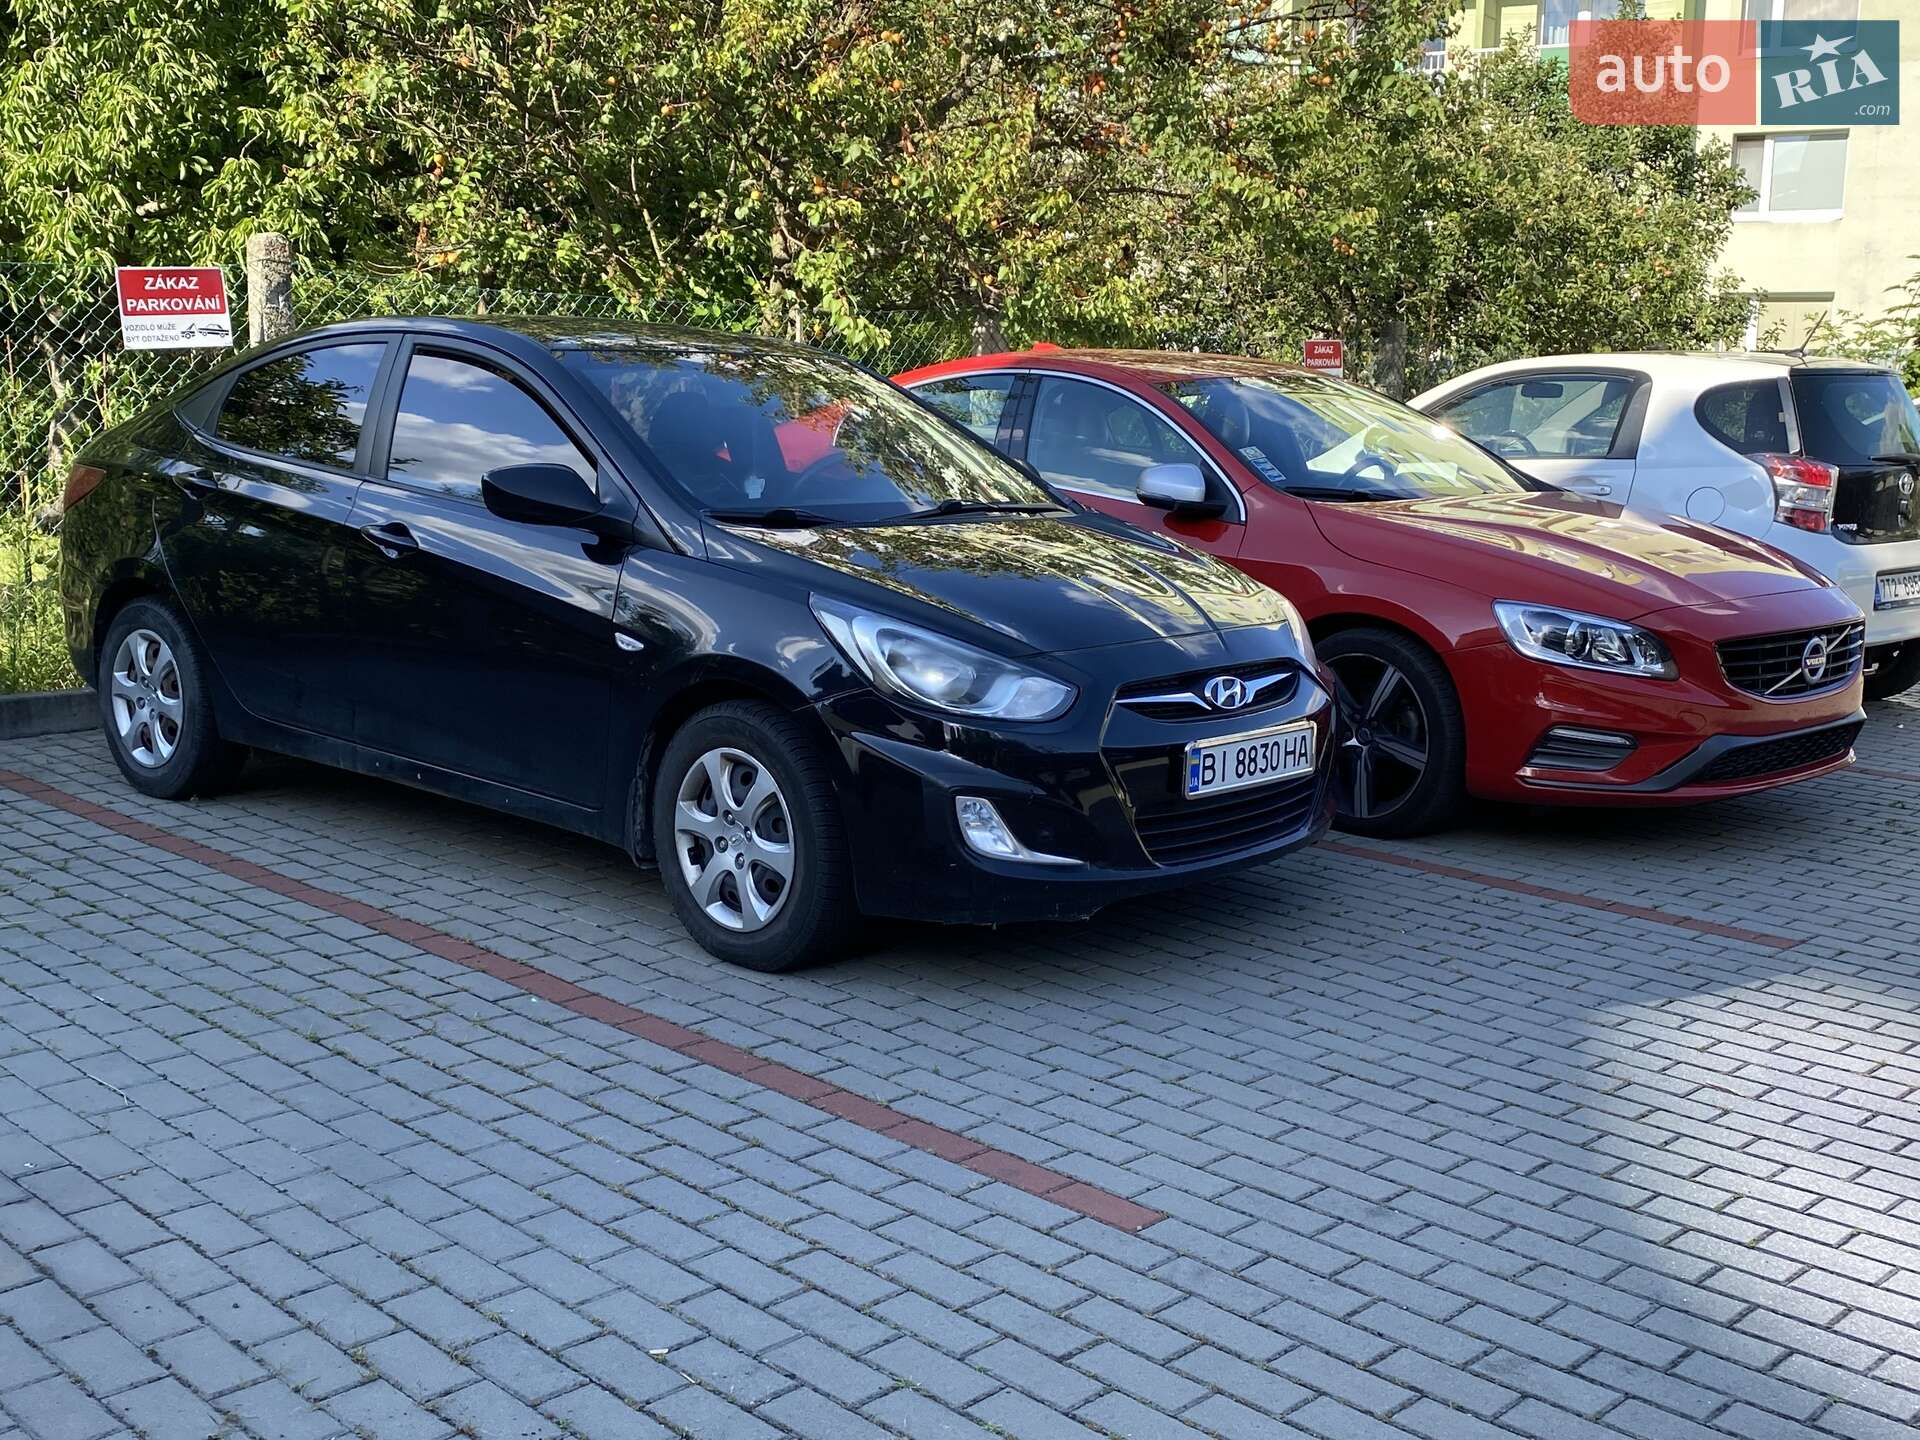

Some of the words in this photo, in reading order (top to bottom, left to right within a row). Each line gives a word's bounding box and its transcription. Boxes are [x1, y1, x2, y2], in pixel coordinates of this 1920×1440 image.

[144, 274, 200, 290] ZÁKAZ
[126, 294, 221, 312] PARKOVÁNÍ
[124, 323, 156, 332] VOZIDLO
[1314, 344, 1334, 354] ZÁKAZ
[1880, 577, 1899, 598] 7T2
[1903, 574, 1920, 596] 695
[1201, 750, 1226, 786] BI
[1235, 740, 1281, 779] 8830
[1283, 734, 1309, 769] HA
